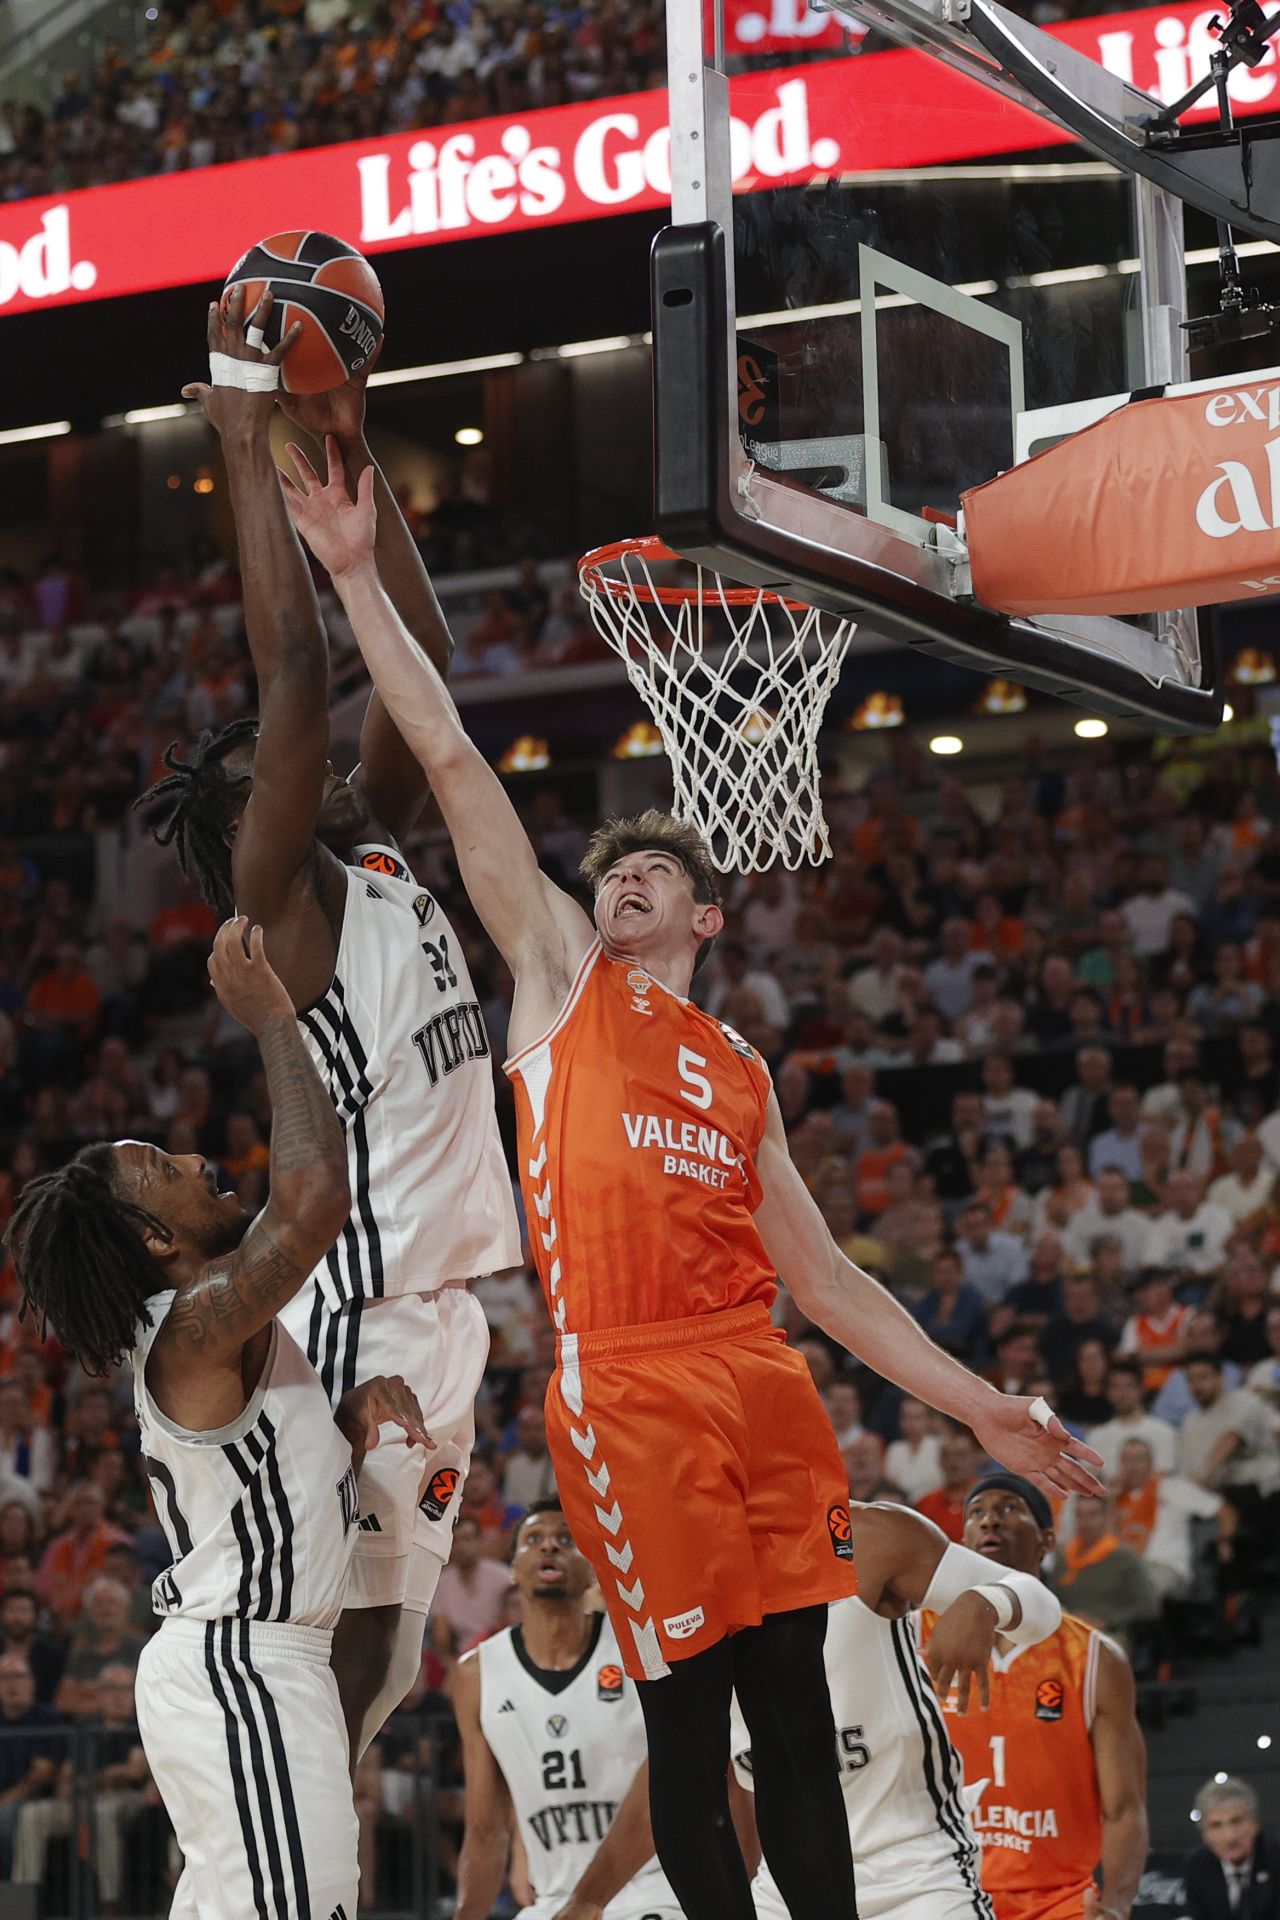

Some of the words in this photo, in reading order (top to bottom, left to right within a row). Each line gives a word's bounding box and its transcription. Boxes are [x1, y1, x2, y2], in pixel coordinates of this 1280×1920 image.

[357, 125, 566, 242] Life's
[677, 1043, 713, 1110] 5
[663, 1154, 730, 1190] BASKET
[667, 1613, 702, 1633] PULEVA
[542, 1748, 586, 1790] 21
[988, 1735, 1007, 1788] 1
